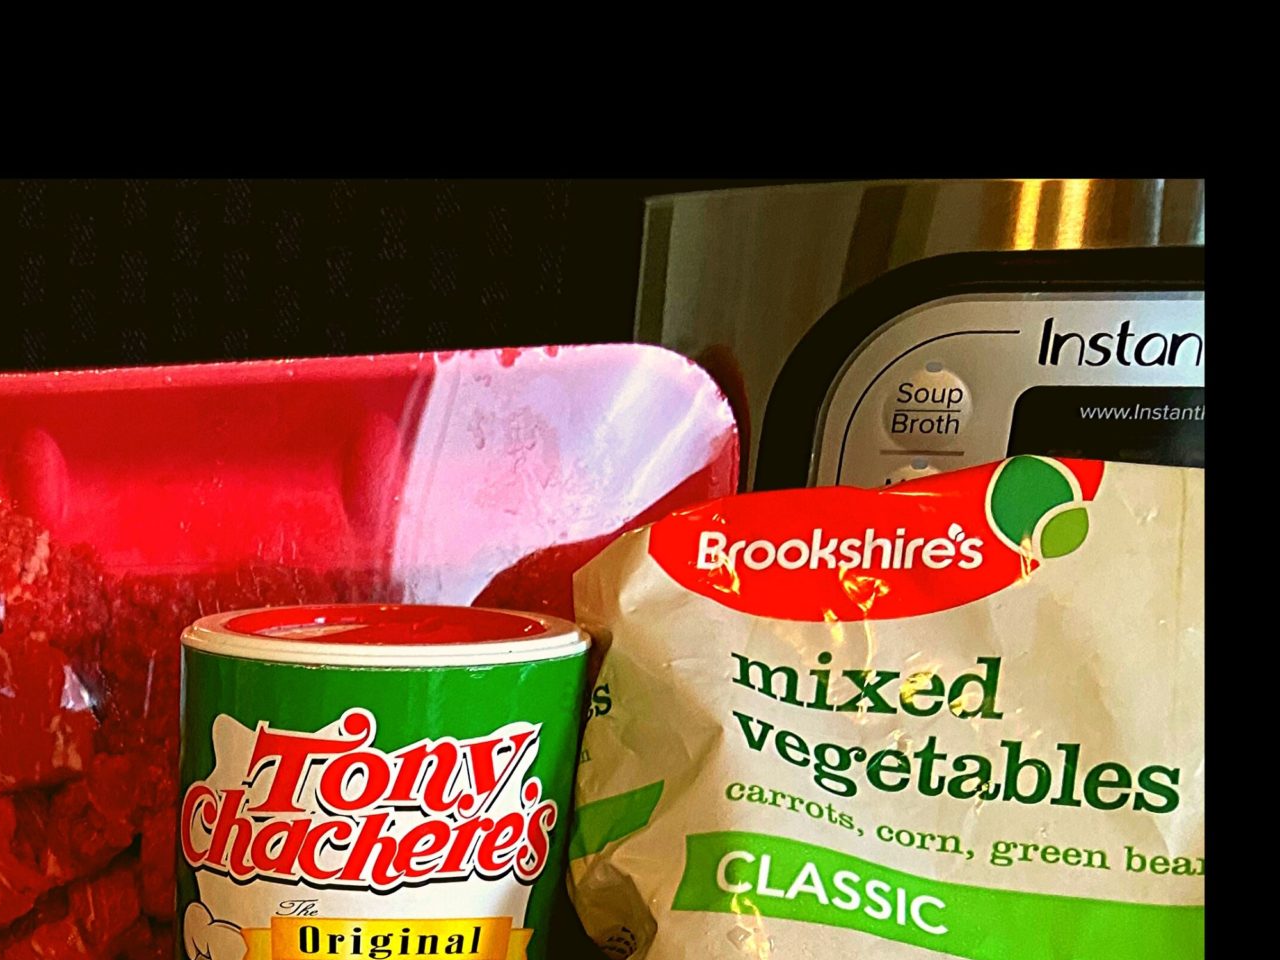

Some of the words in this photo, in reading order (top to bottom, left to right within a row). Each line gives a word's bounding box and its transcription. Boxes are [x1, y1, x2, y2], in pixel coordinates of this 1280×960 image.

[891, 413, 960, 435] Broth
[896, 382, 964, 405] Soup
[696, 522, 984, 572] Brookshire's
[729, 650, 1005, 721] mixed
[246, 712, 538, 818] Tony
[731, 709, 1181, 815] vegetables
[182, 781, 556, 886] Chachere's
[725, 777, 865, 837] carrots,
[876, 822, 975, 862] corn,
[990, 842, 1110, 876] green
[276, 899, 319, 917] The
[716, 851, 949, 936] CLASSIC
[298, 926, 481, 959] Original
